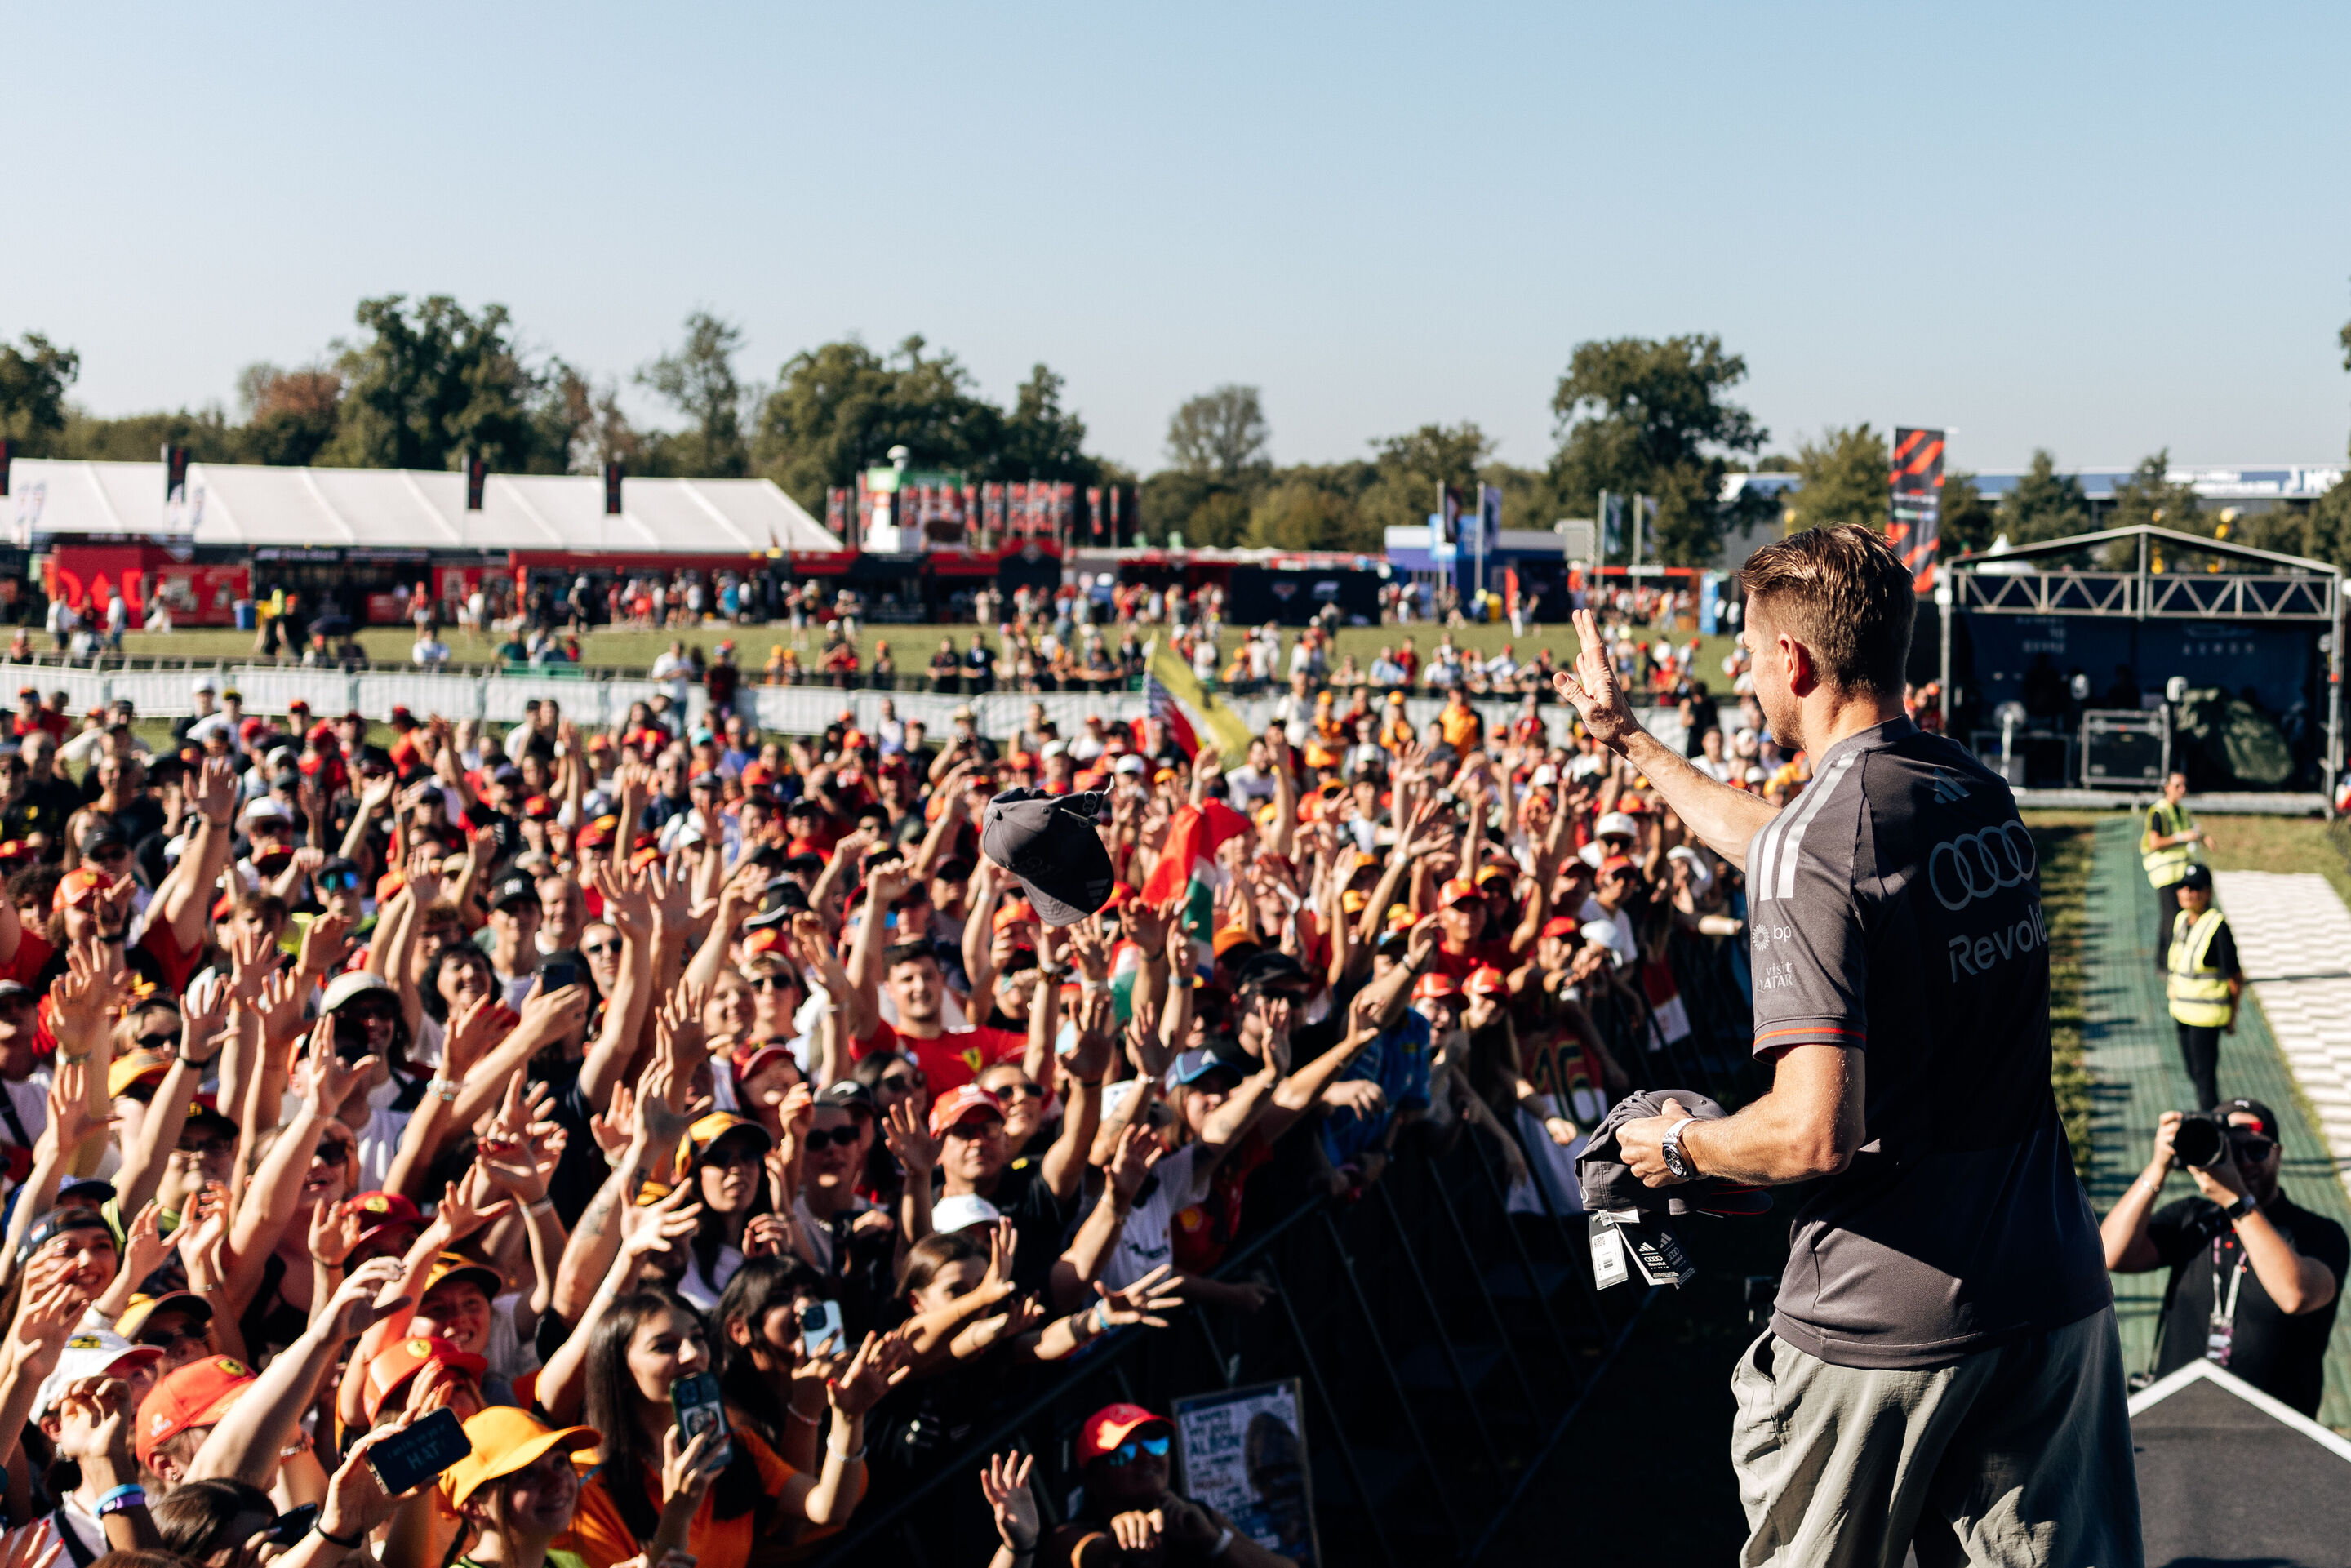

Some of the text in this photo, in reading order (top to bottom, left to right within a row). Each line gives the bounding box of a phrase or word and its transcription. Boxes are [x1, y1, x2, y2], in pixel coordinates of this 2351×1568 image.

[1773, 924, 1791, 942] bp
[1948, 899, 2048, 984] Revolu
[1765, 961, 1792, 975] visit
[1534, 1040, 1601, 1133] 16
